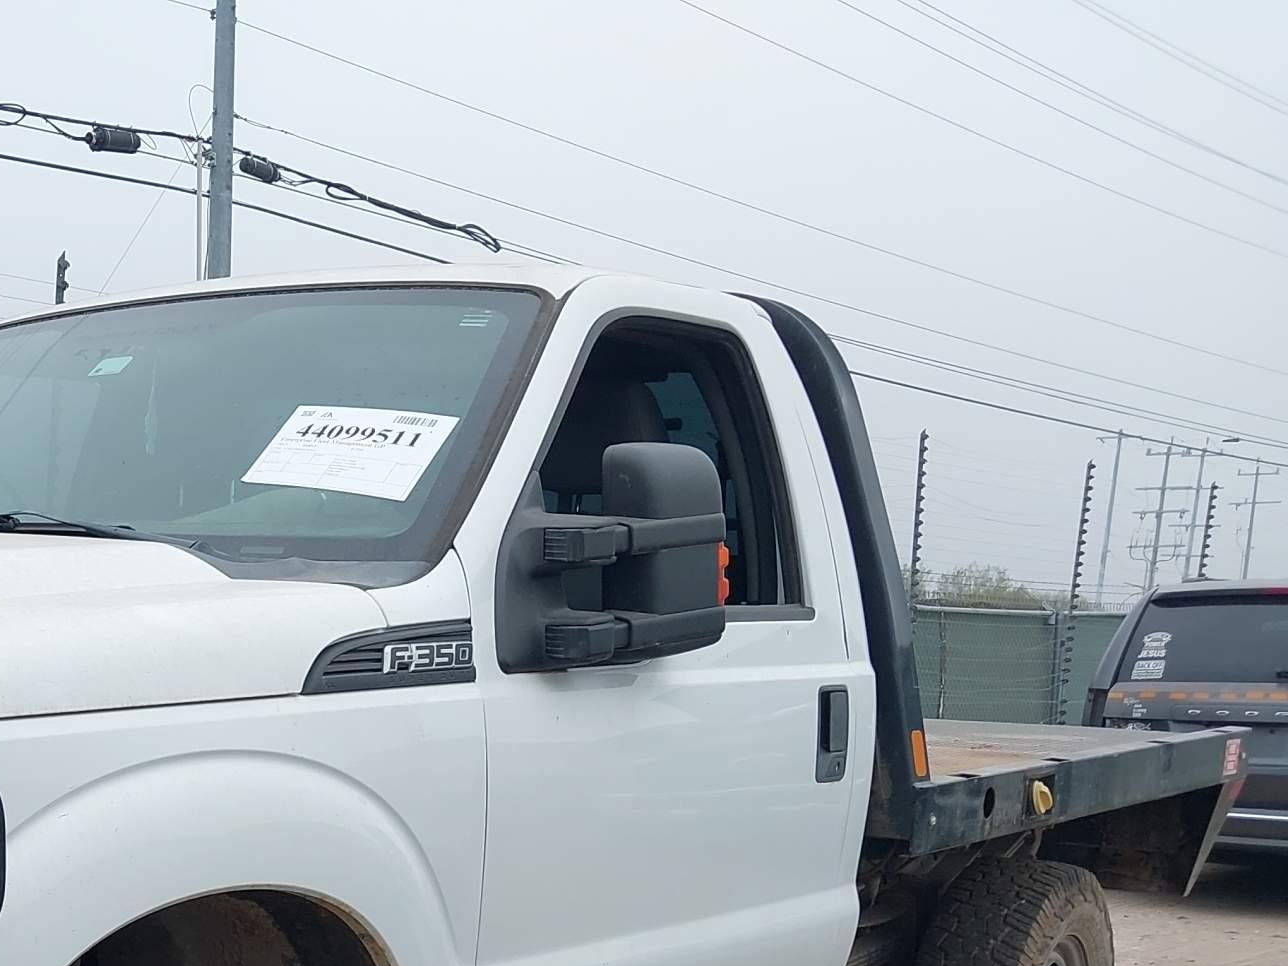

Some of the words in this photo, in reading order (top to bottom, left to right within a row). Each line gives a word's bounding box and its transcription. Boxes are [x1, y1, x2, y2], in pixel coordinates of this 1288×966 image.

[296, 423, 422, 447] 44099511
[383, 641, 473, 673] F-350
[1137, 649, 1167, 658] JESUS
